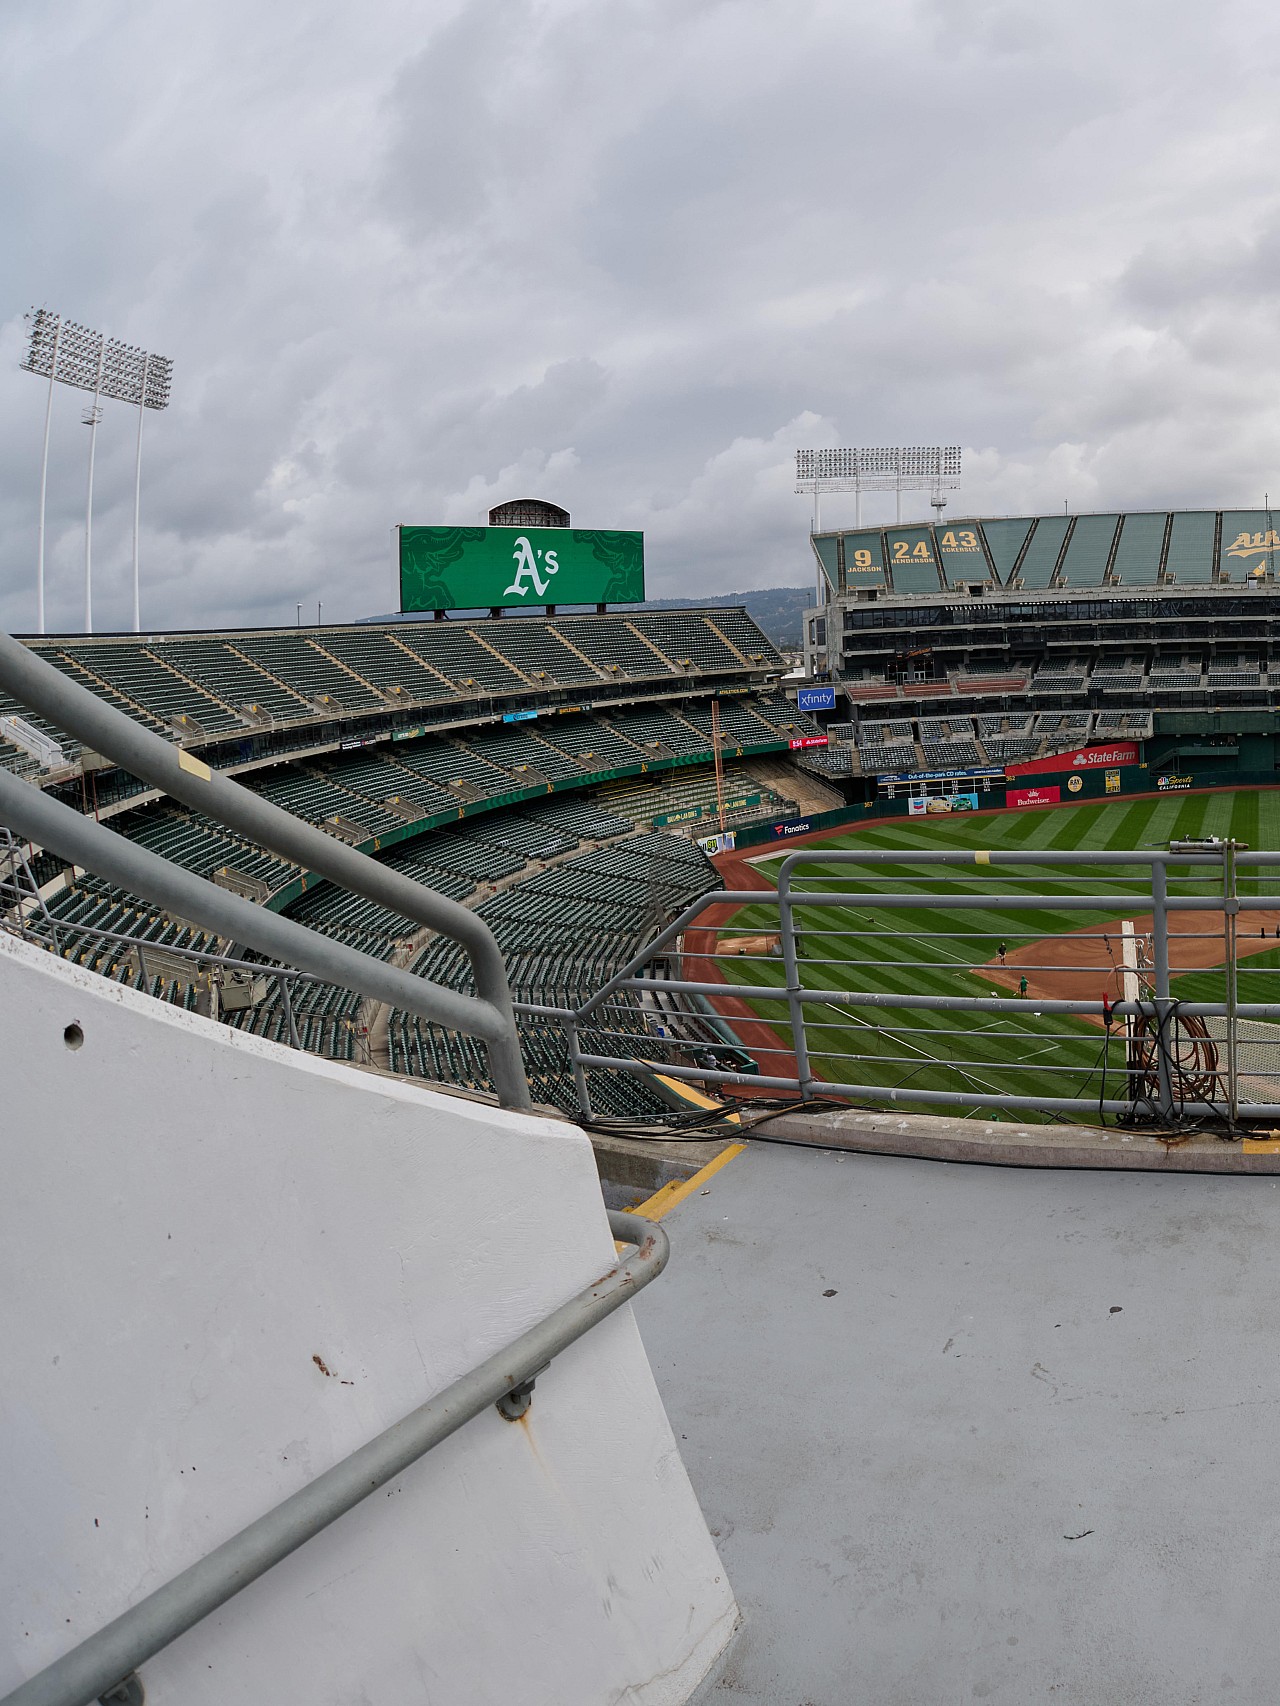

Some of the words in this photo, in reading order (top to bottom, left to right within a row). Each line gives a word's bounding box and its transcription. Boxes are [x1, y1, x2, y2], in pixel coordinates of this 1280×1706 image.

[941, 531, 977, 547] 43
[893, 541, 930, 558] 24
[854, 549, 872, 567] 9
[503, 536, 559, 597] A's
[801, 693, 832, 706] xfinity
[1168, 776, 1193, 785] Sports
[784, 823, 809, 834] Fanatics
